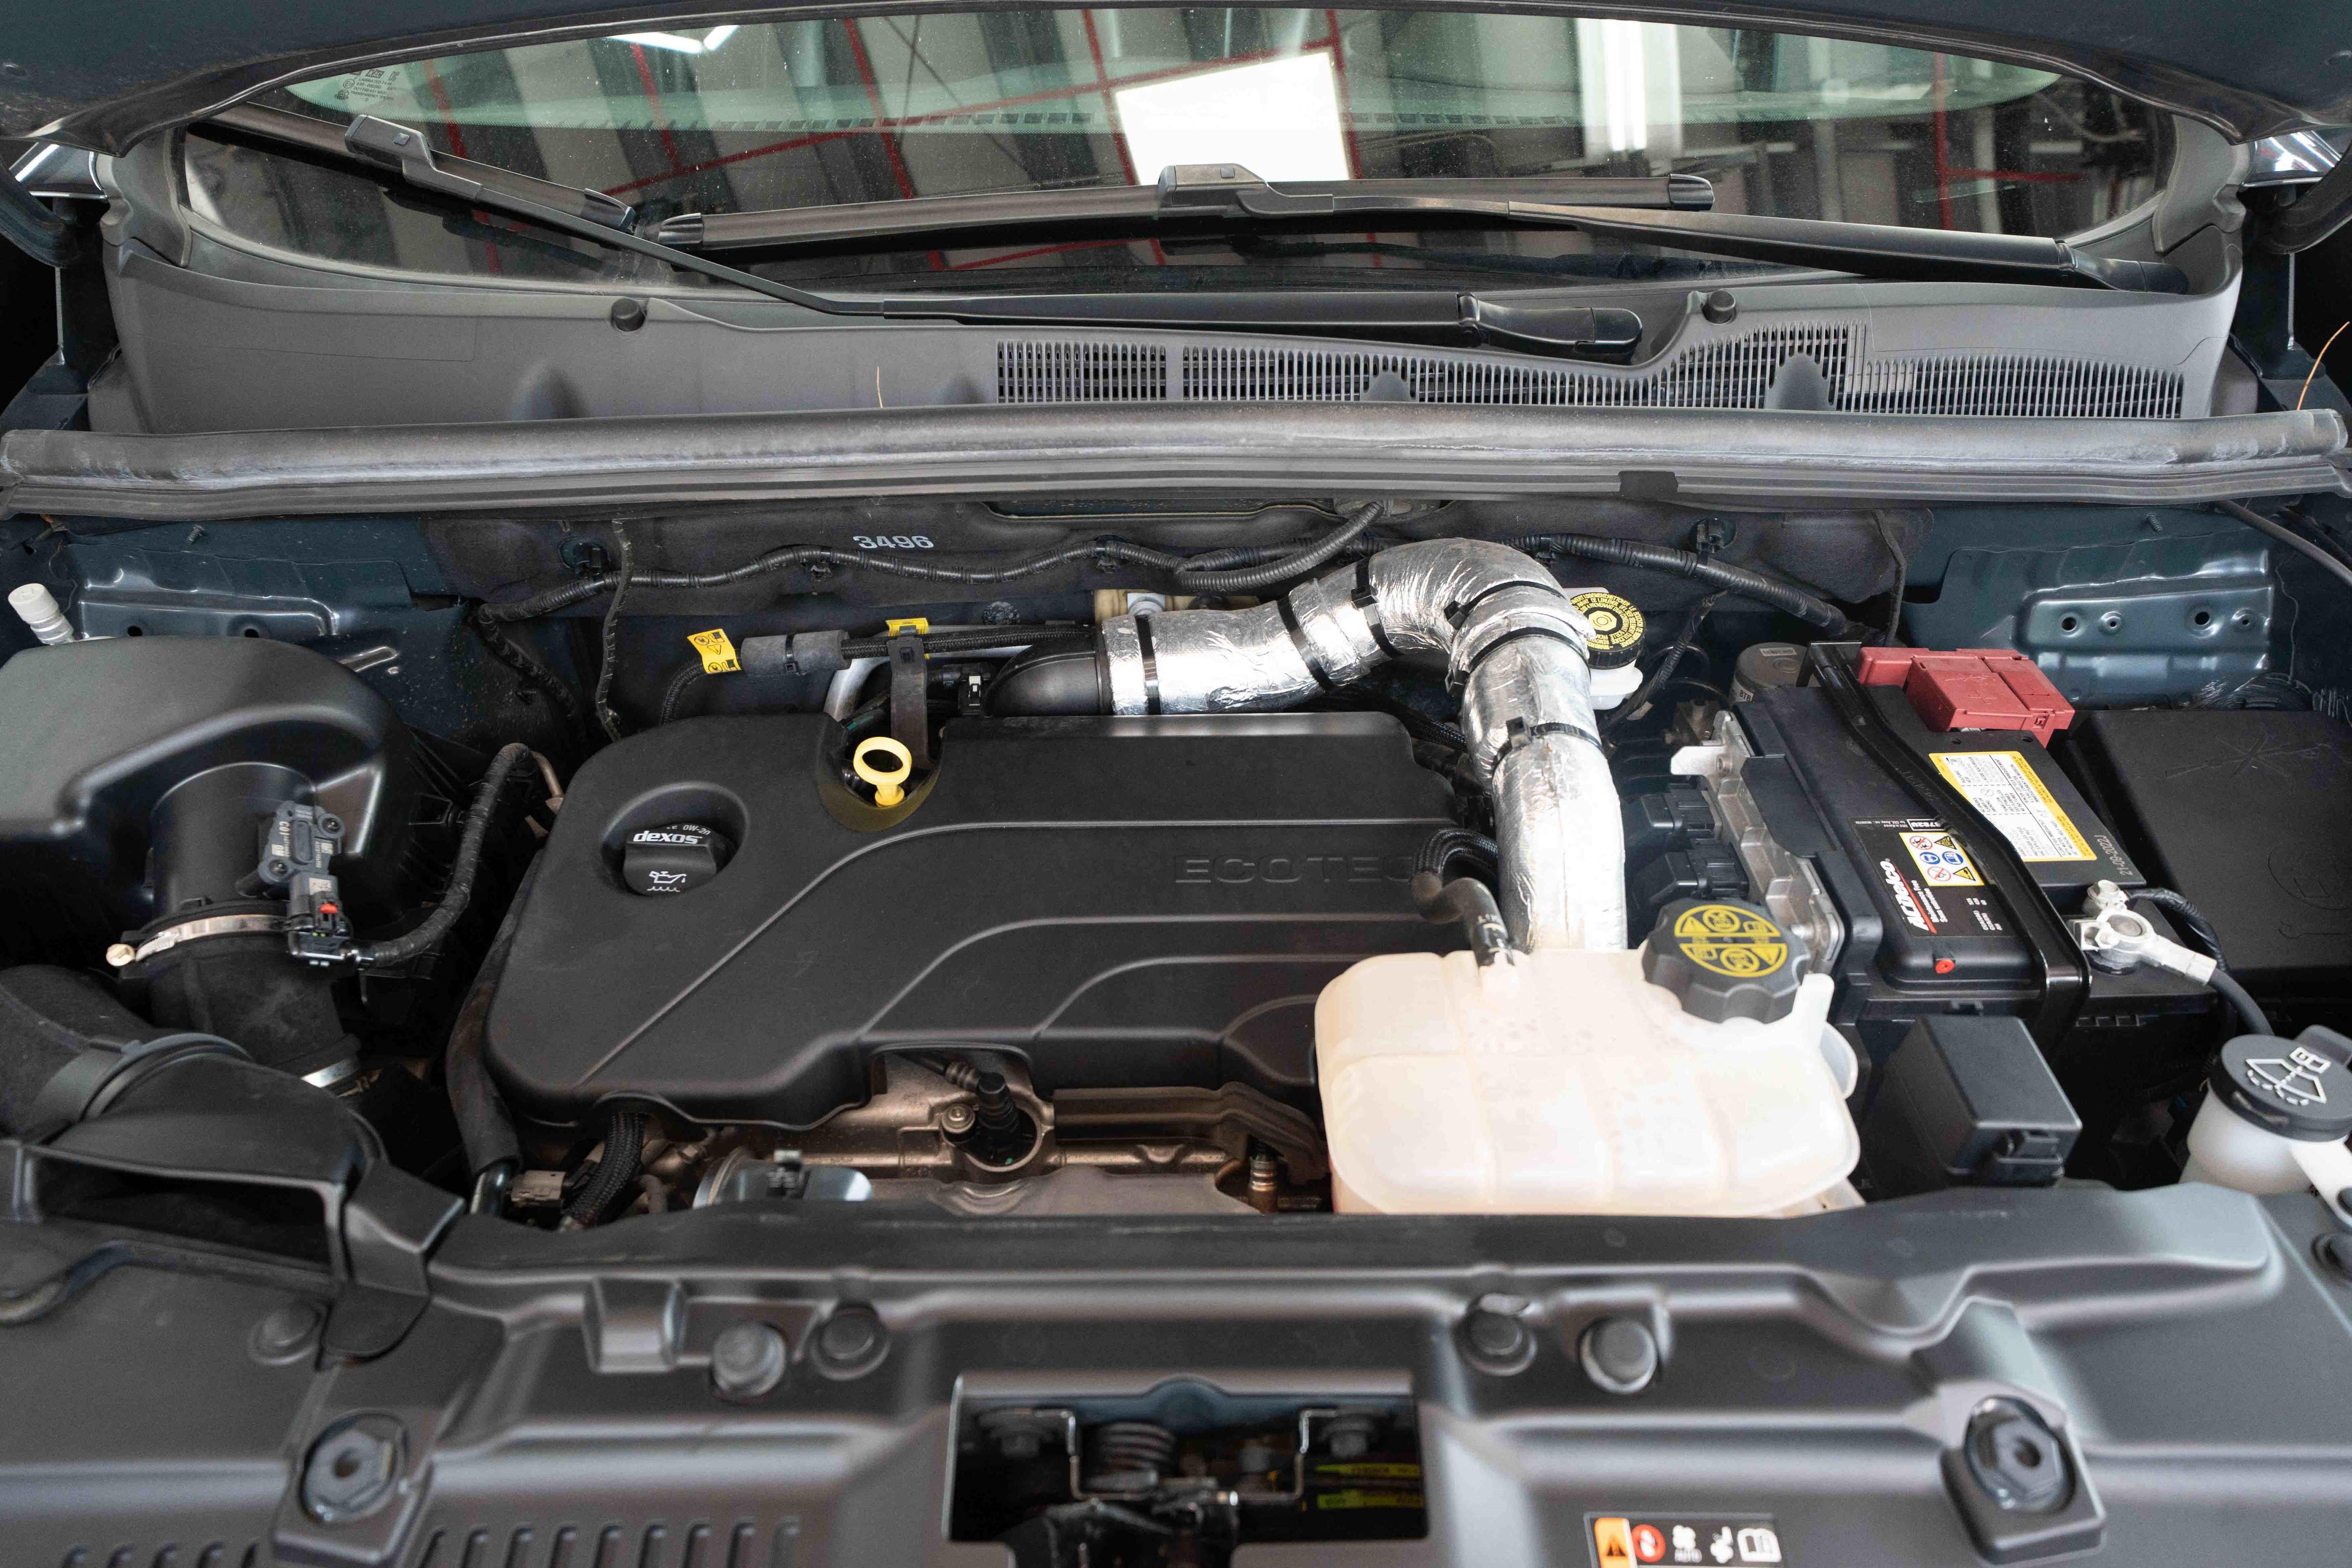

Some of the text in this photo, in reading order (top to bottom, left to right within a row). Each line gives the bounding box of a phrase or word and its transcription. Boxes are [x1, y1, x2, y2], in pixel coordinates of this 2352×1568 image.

[853, 536, 934, 549] 3496
[682, 824, 711, 835] 0W-20
[1911, 880, 1940, 922] Maintenance Free
